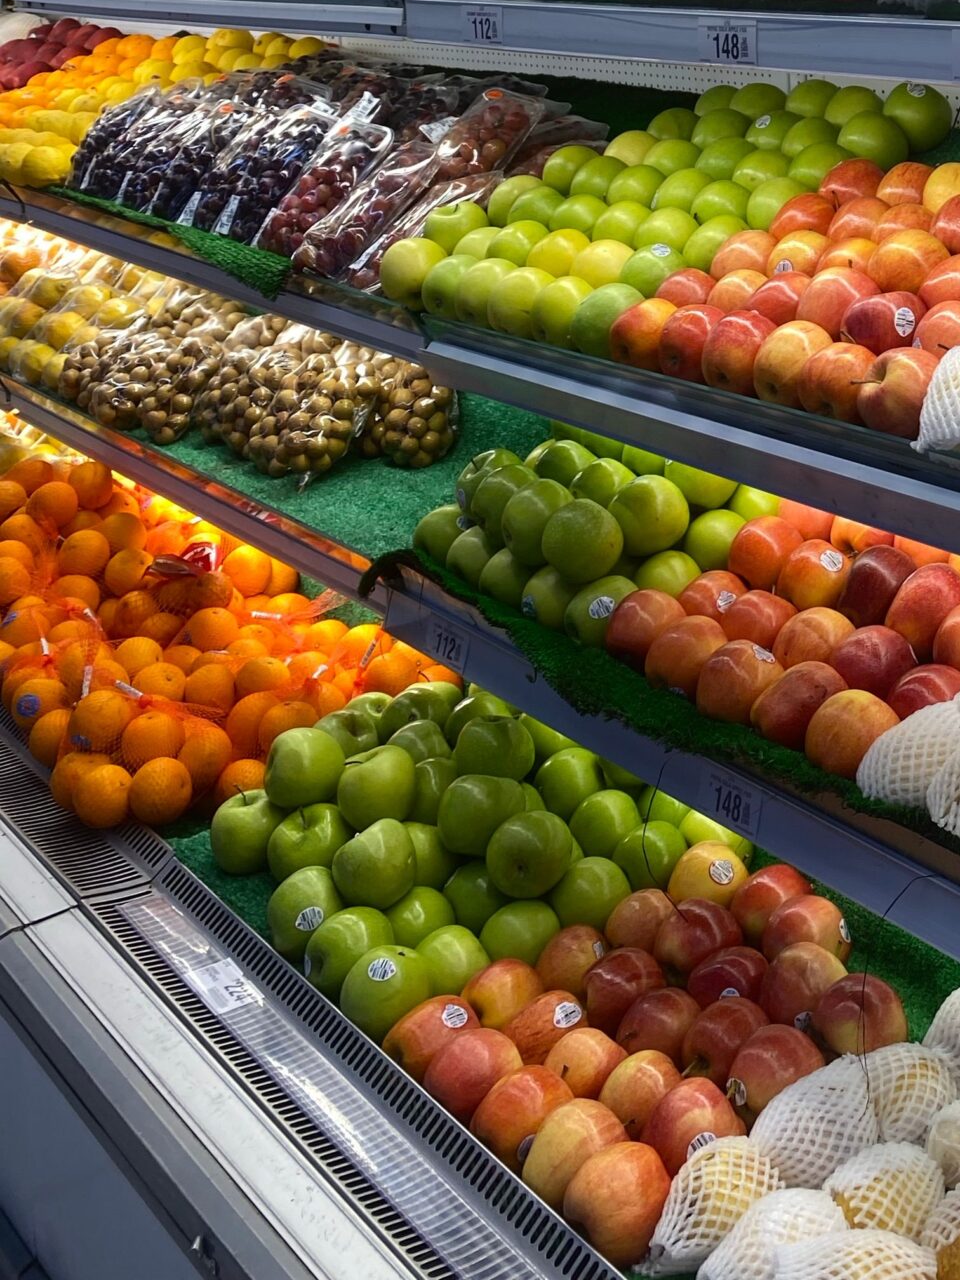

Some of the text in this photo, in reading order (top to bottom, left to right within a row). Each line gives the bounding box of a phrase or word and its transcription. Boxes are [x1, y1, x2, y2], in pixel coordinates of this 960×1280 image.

[471, 17, 492, 40] 112
[712, 33, 740, 60] 148
[435, 632, 456, 660] 112
[715, 786, 742, 822] 148
